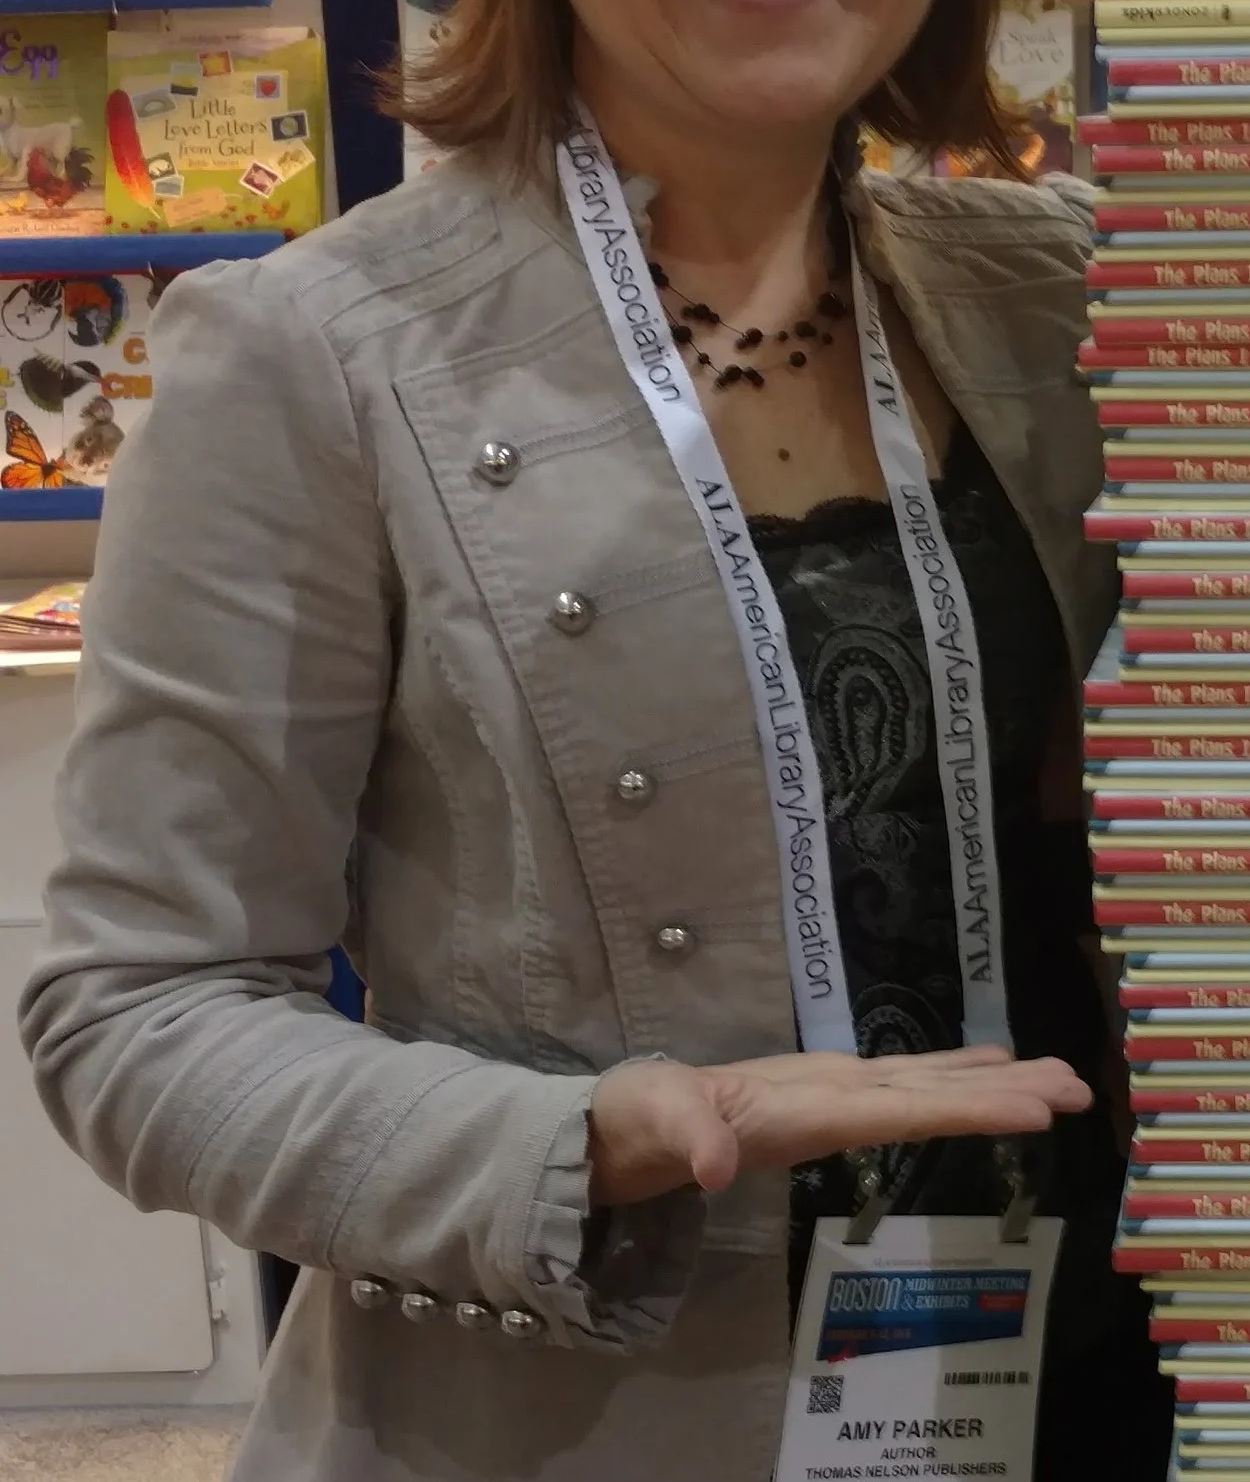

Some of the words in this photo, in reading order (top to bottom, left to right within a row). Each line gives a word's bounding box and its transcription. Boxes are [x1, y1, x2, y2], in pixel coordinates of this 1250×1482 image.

[1177, 59, 1212, 86] The
[189, 98, 236, 119] Little
[163, 120, 201, 141] Love
[204, 119, 268, 141] Letters
[1147, 120, 1180, 145] The
[1186, 119, 1233, 144] Plans
[1241, 119, 1250, 144] I
[178, 142, 212, 160] from
[218, 140, 255, 157] God
[1161, 147, 1195, 173] The
[1201, 146, 1249, 172] Plans
[1165, 318, 1197, 344] The
[1203, 318, 1250, 344] Plans
[1174, 461, 1206, 482] The
[1162, 903, 1195, 925] The
[1200, 903, 1246, 925] Plans
[1202, 1142, 1233, 1163] The
[829, 1276, 904, 1313] BOSTON
[836, 1419, 888, 1442] AMY
[892, 1417, 986, 1441] PARKER
[880, 1445, 937, 1461] AUTHOR
[805, 1465, 864, 1481] THOMAS
[864, 1464, 921, 1478] NELSON
[922, 1461, 1008, 1477] PUBLISHERS
